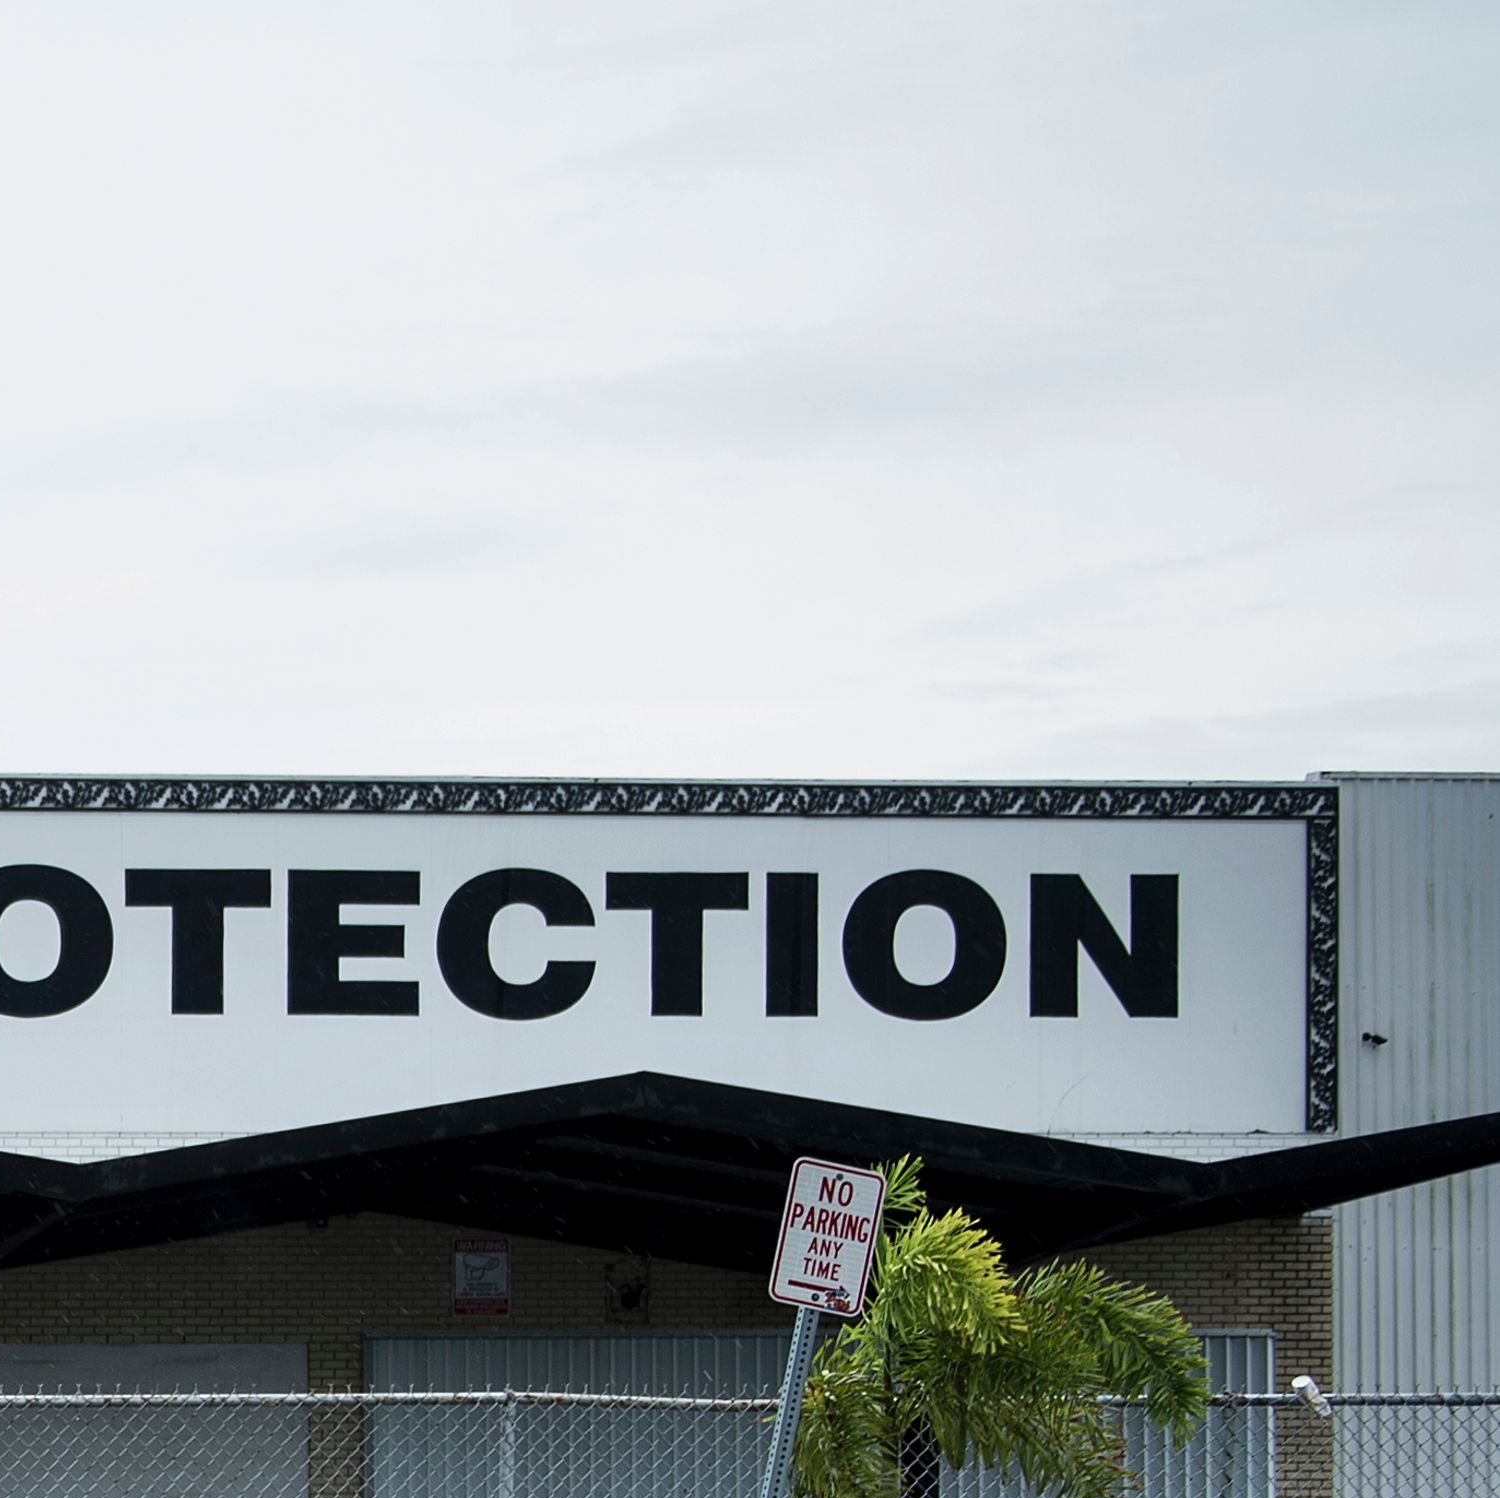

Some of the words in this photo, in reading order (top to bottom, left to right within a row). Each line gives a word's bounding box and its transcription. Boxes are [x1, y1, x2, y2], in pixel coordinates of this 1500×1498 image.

[818, 1176, 854, 1207] NO
[789, 1202, 871, 1244] PARKING
[456, 1240, 506, 1251] WARNING
[807, 1237, 844, 1260] ANY
[803, 1257, 842, 1282] TIME
